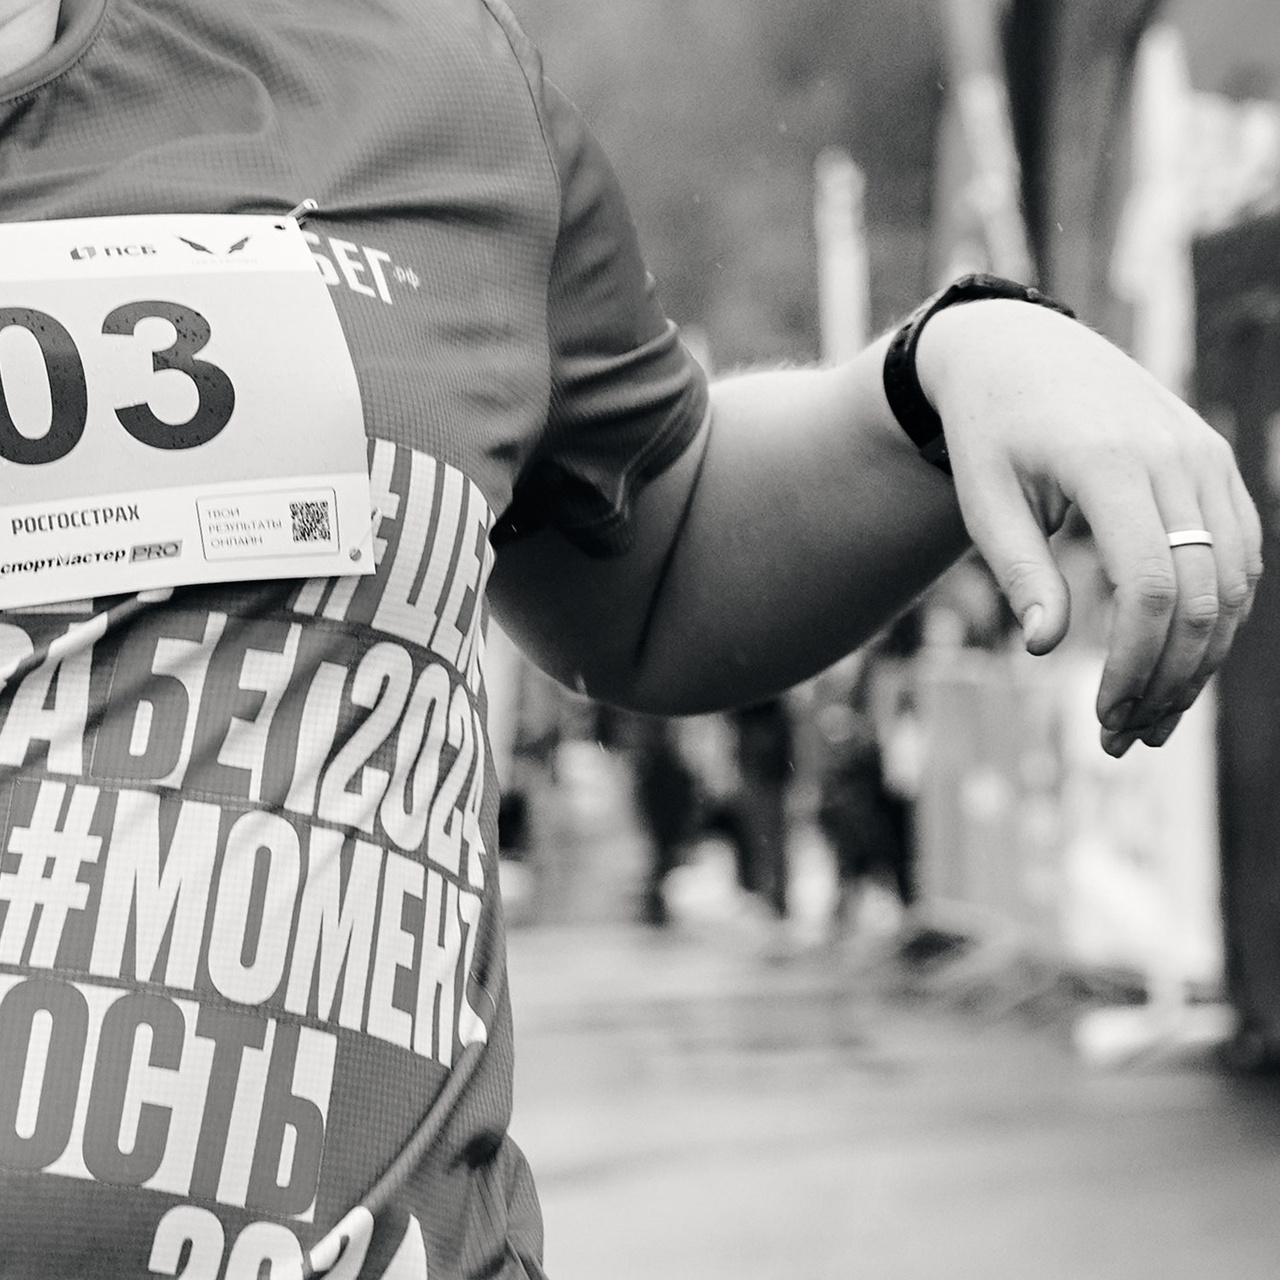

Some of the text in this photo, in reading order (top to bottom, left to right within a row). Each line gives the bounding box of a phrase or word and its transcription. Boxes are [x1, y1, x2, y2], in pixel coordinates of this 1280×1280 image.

[104, 244, 157, 257] ПСБ
[11, 504, 141, 535] РОСГОССТРАХ
[208, 519, 282, 534] РЕЗУЛЬТАТЫ
[132, 541, 180, 562] PRO
[317, 640, 487, 892] 2024
